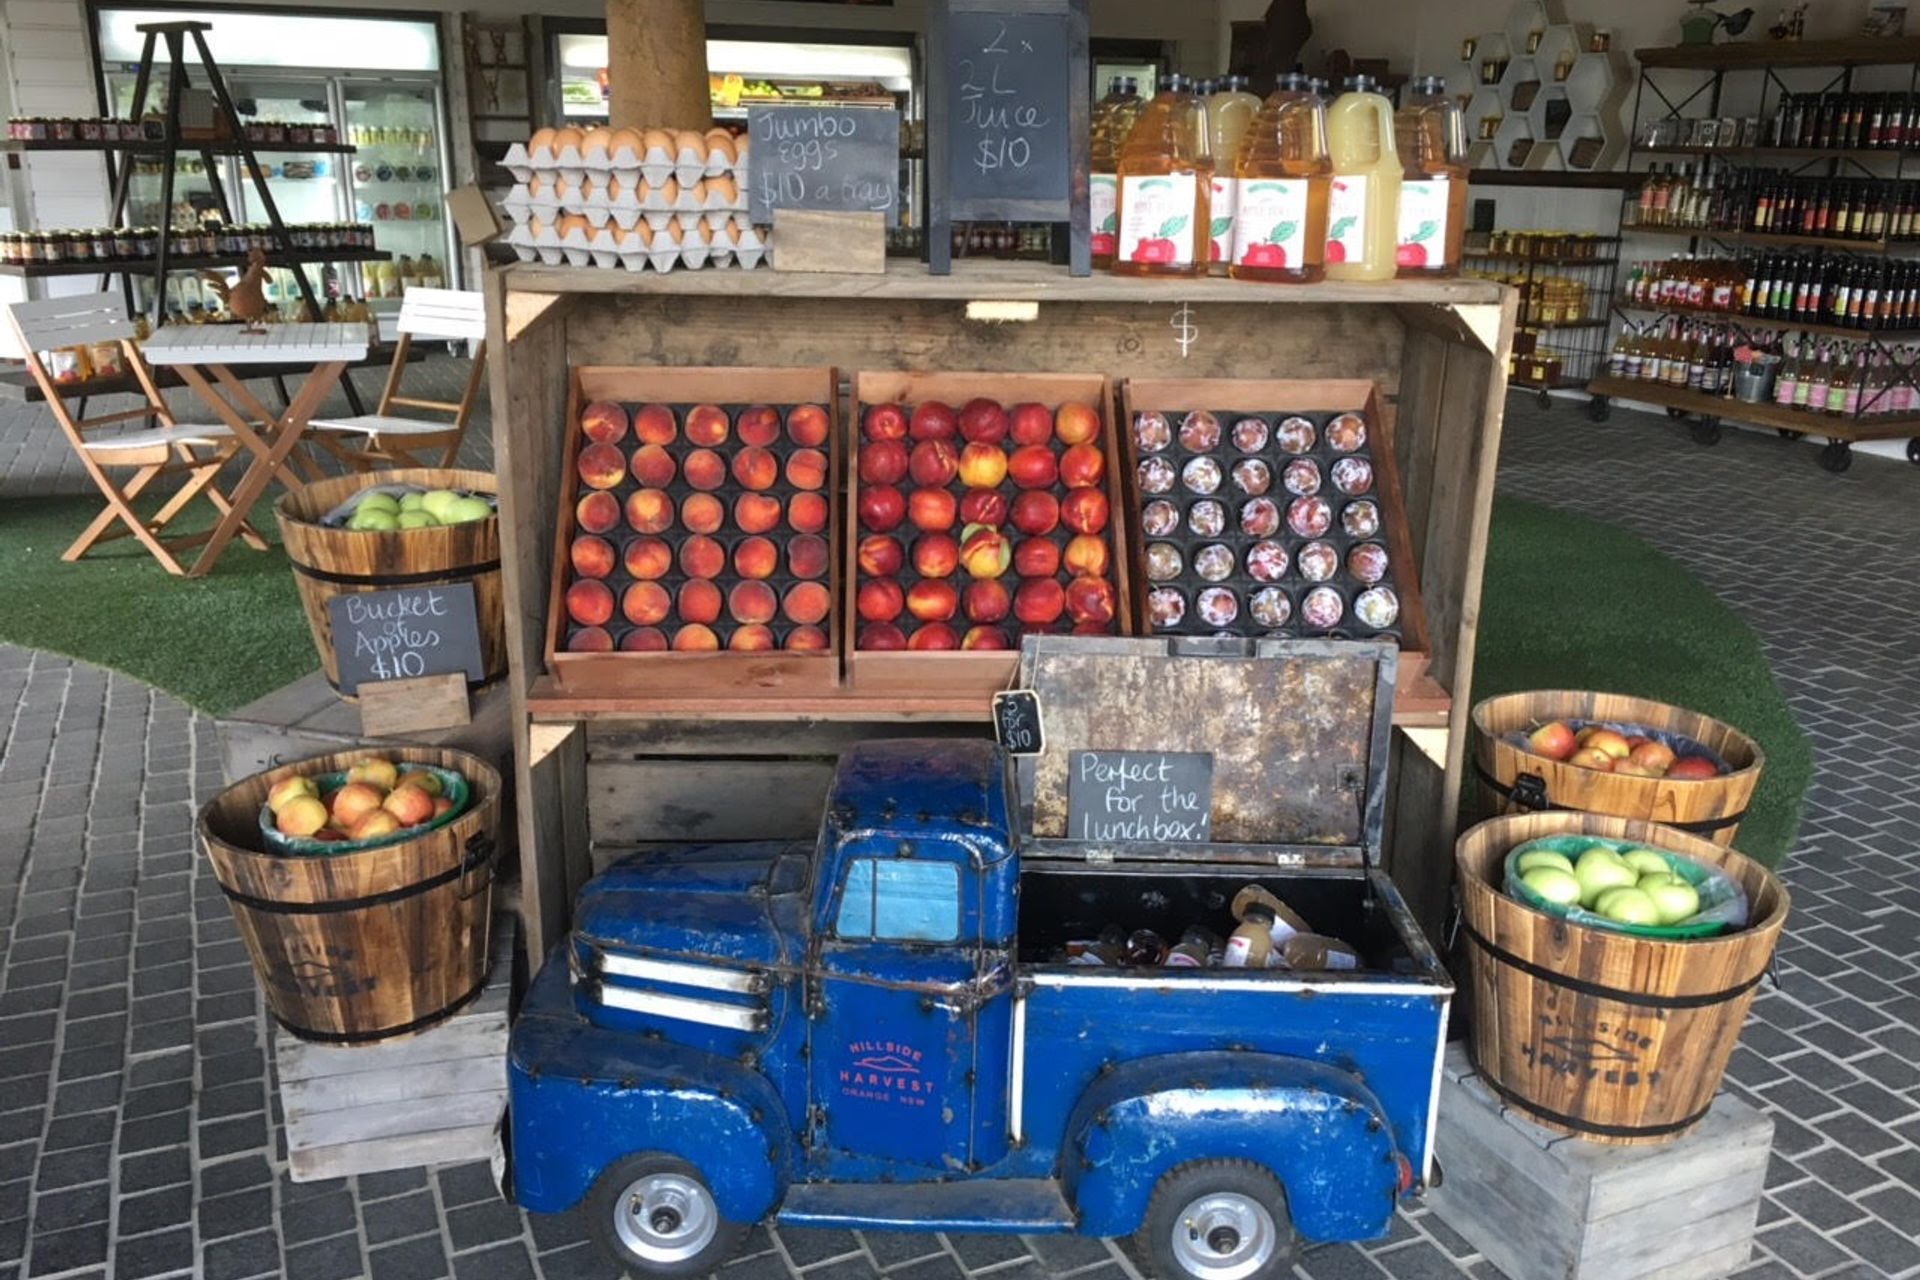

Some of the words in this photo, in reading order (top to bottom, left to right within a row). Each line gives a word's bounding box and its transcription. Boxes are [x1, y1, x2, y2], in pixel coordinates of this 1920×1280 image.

[960, 93, 1050, 129] Juice
[758, 111, 857, 142] Jumbo
[974, 132, 1031, 175] $10
[758, 170, 805, 209] $10
[815, 184, 831, 201] a
[1169, 301, 1199, 358] $
[346, 590, 448, 624] Bucket
[354, 628, 441, 658] Apples
[370, 651, 425, 680] $10
[1006, 727, 1032, 751] $10
[1080, 752, 1174, 790] Perfect
[1105, 787, 1144, 813] for
[1160, 785, 1201, 814] the
[849, 1040, 923, 1061] HILLSIDE
[840, 1071, 934, 1094] HARVEST
[841, 1087, 890, 1102] ORANGE
